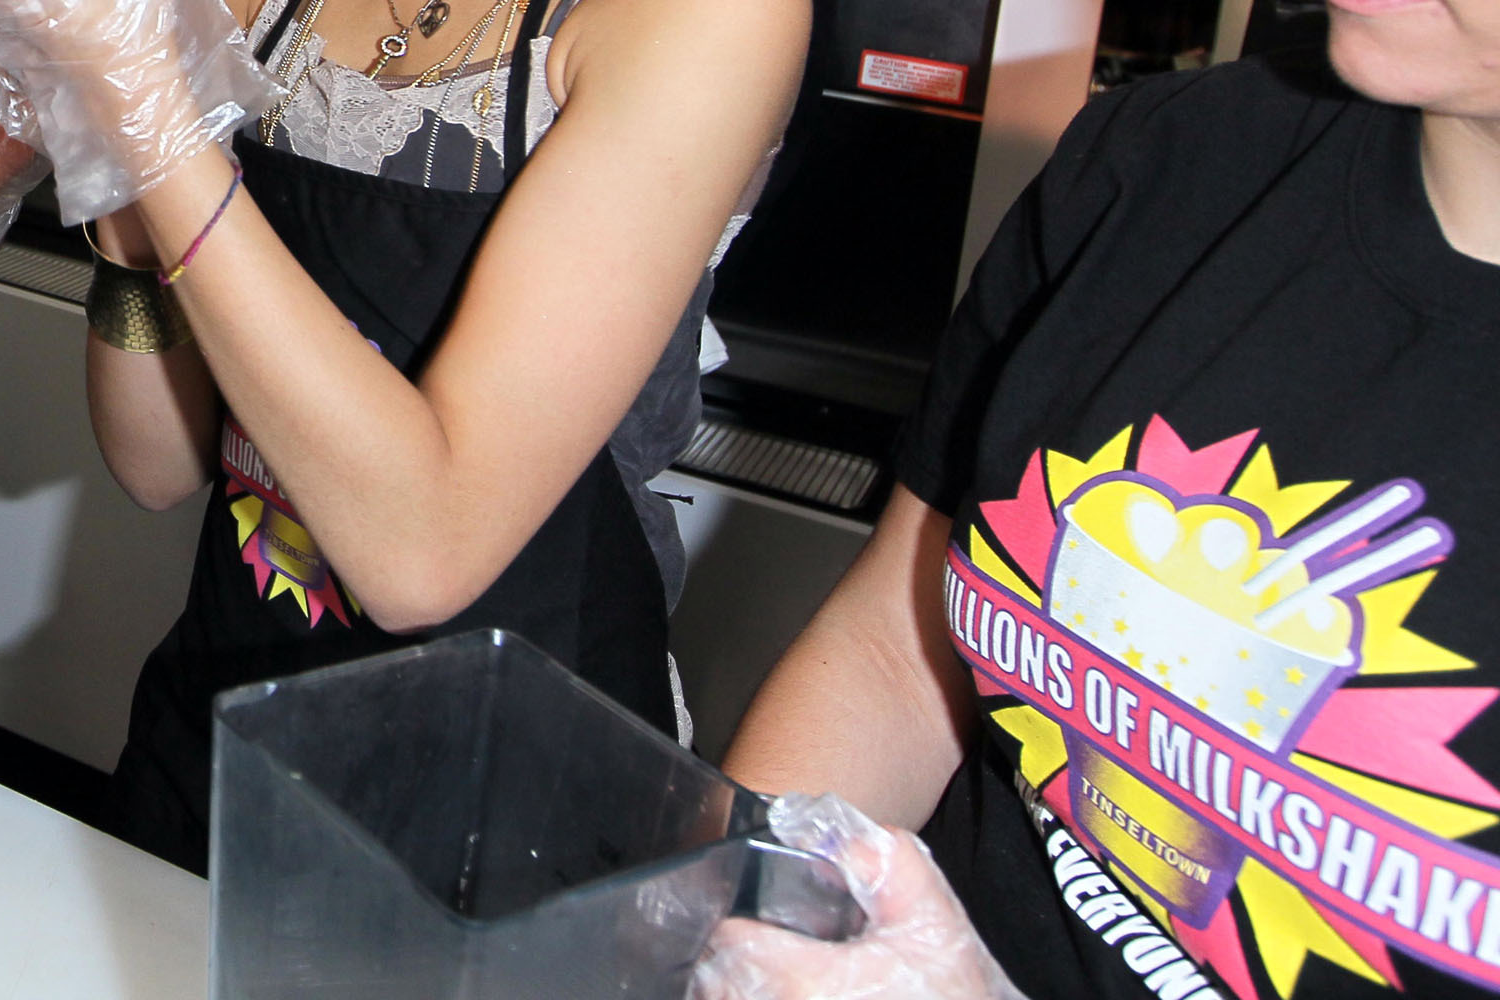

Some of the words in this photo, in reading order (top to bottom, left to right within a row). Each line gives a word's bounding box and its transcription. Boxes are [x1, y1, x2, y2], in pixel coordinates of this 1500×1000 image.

[222, 422, 274, 491] ILLIONS
[1084, 667, 1140, 750] OF
[1080, 776, 1212, 885] TINSELTOWN
